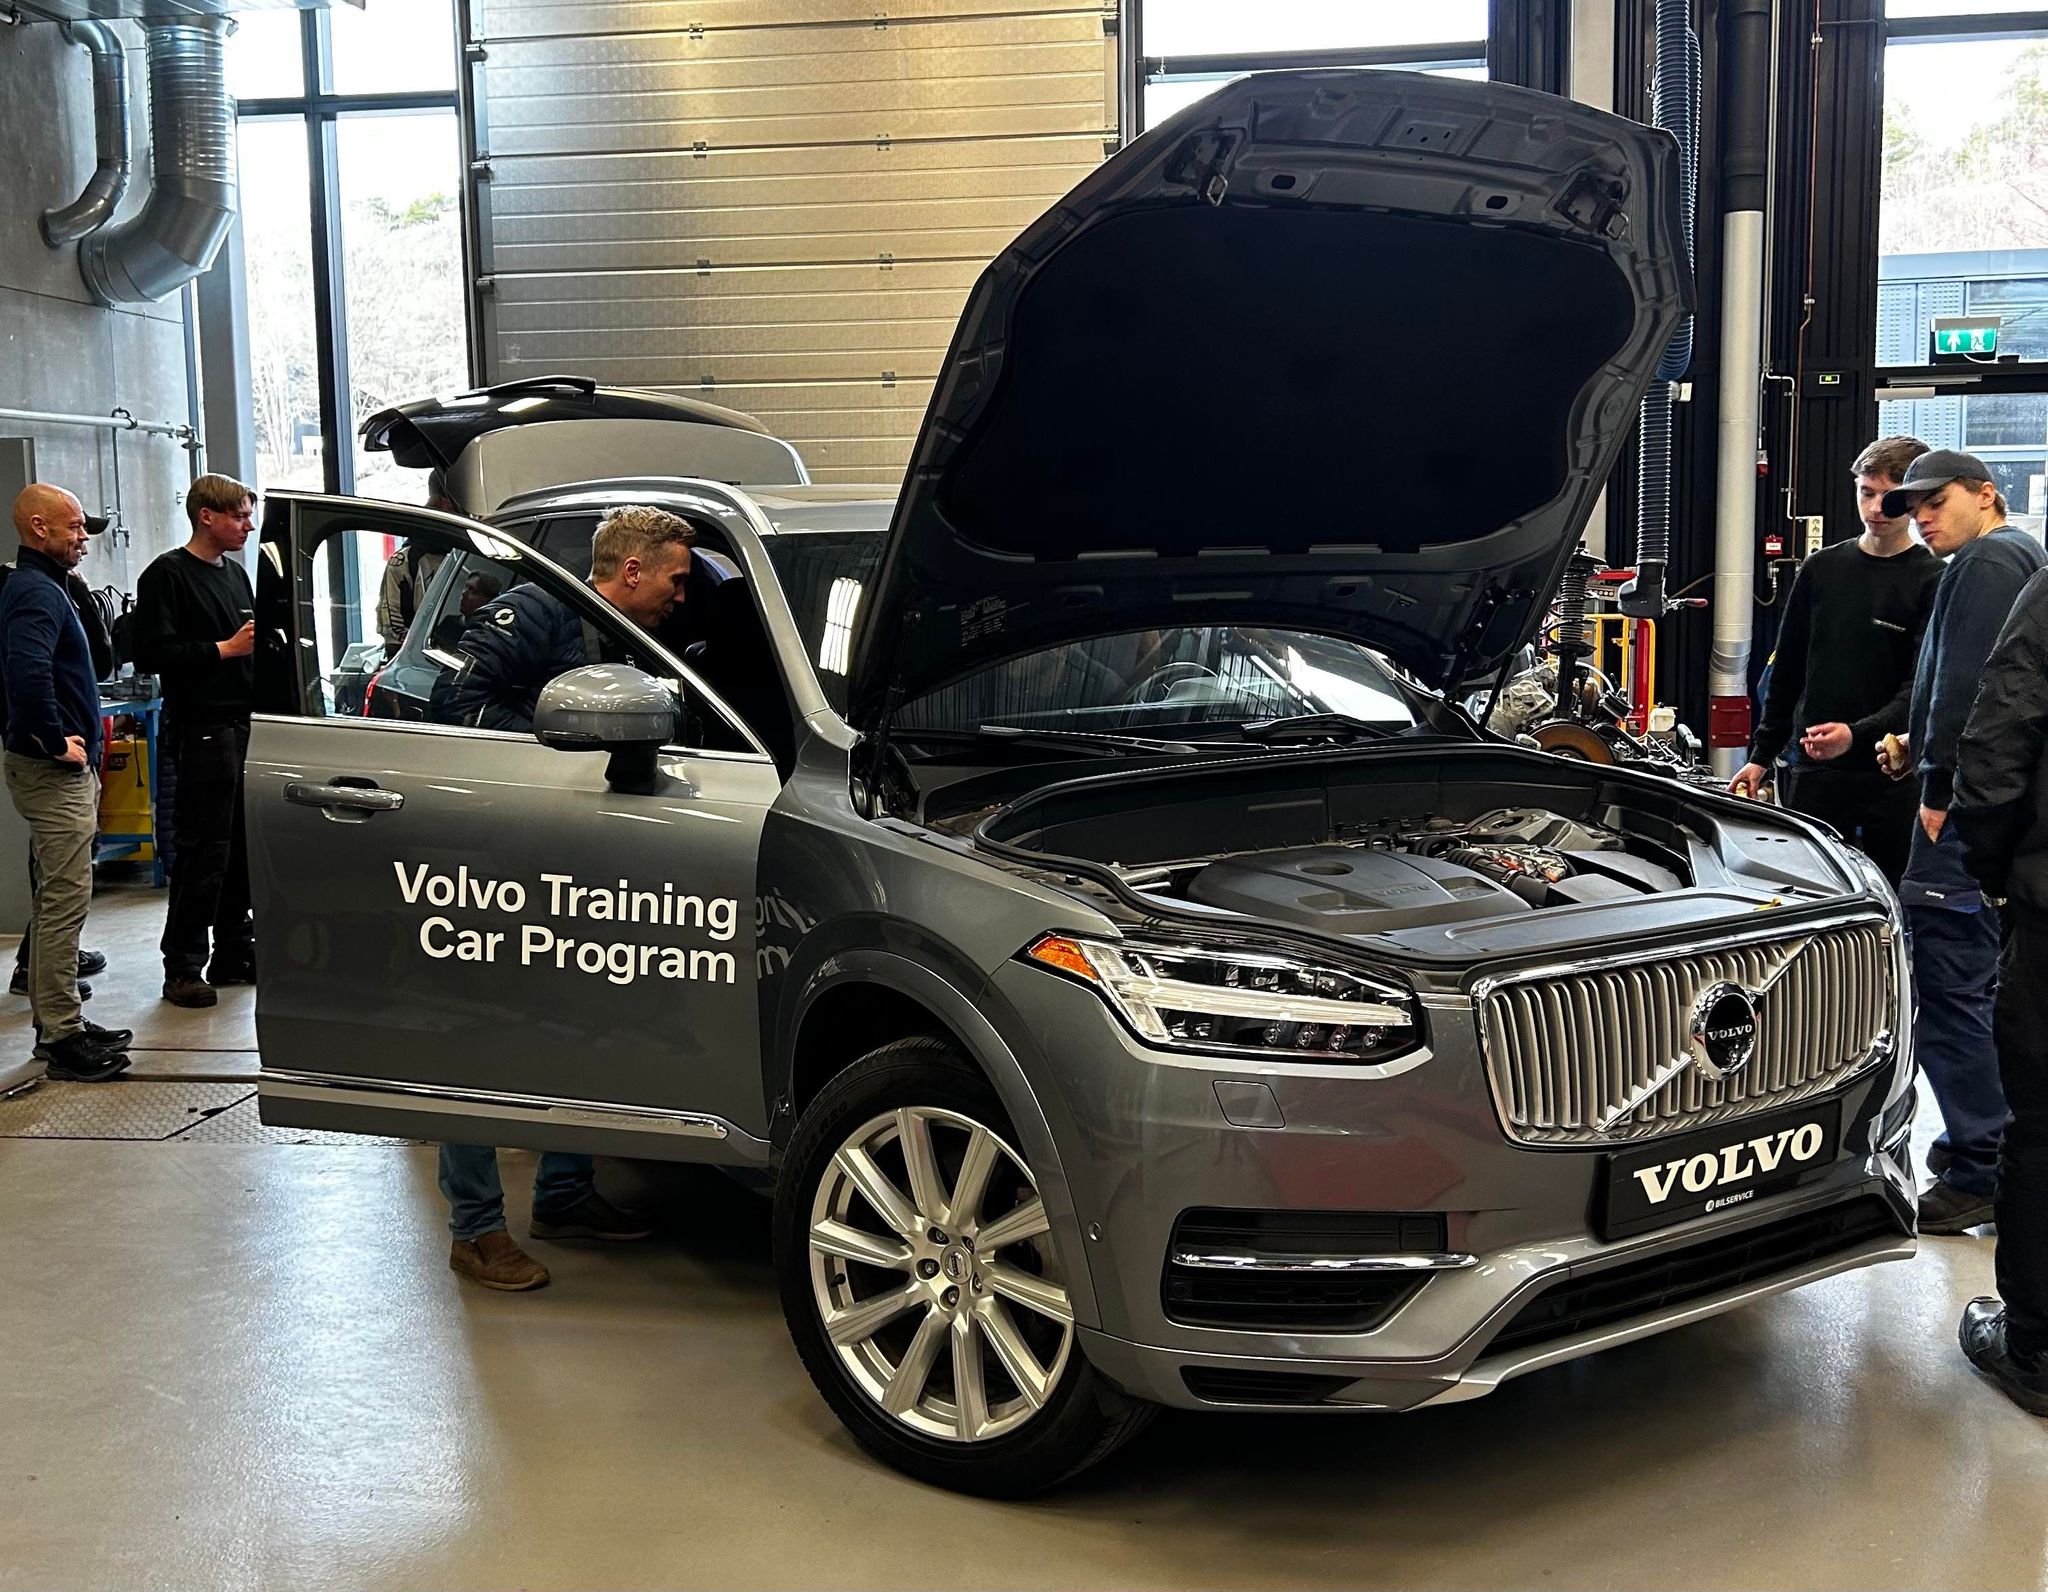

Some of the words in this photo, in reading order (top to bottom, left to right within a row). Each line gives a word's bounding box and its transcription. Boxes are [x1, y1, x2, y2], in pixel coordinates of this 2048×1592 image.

[393, 861, 526, 913] Volvo
[541, 873, 738, 941] Training
[419, 916, 505, 962] Car
[521, 924, 736, 985] Program
[1707, 1024, 1753, 1041] VOLVO
[1633, 1123, 1824, 1204] VOLVO
[1715, 1189, 1755, 1208] BILSERVICE
